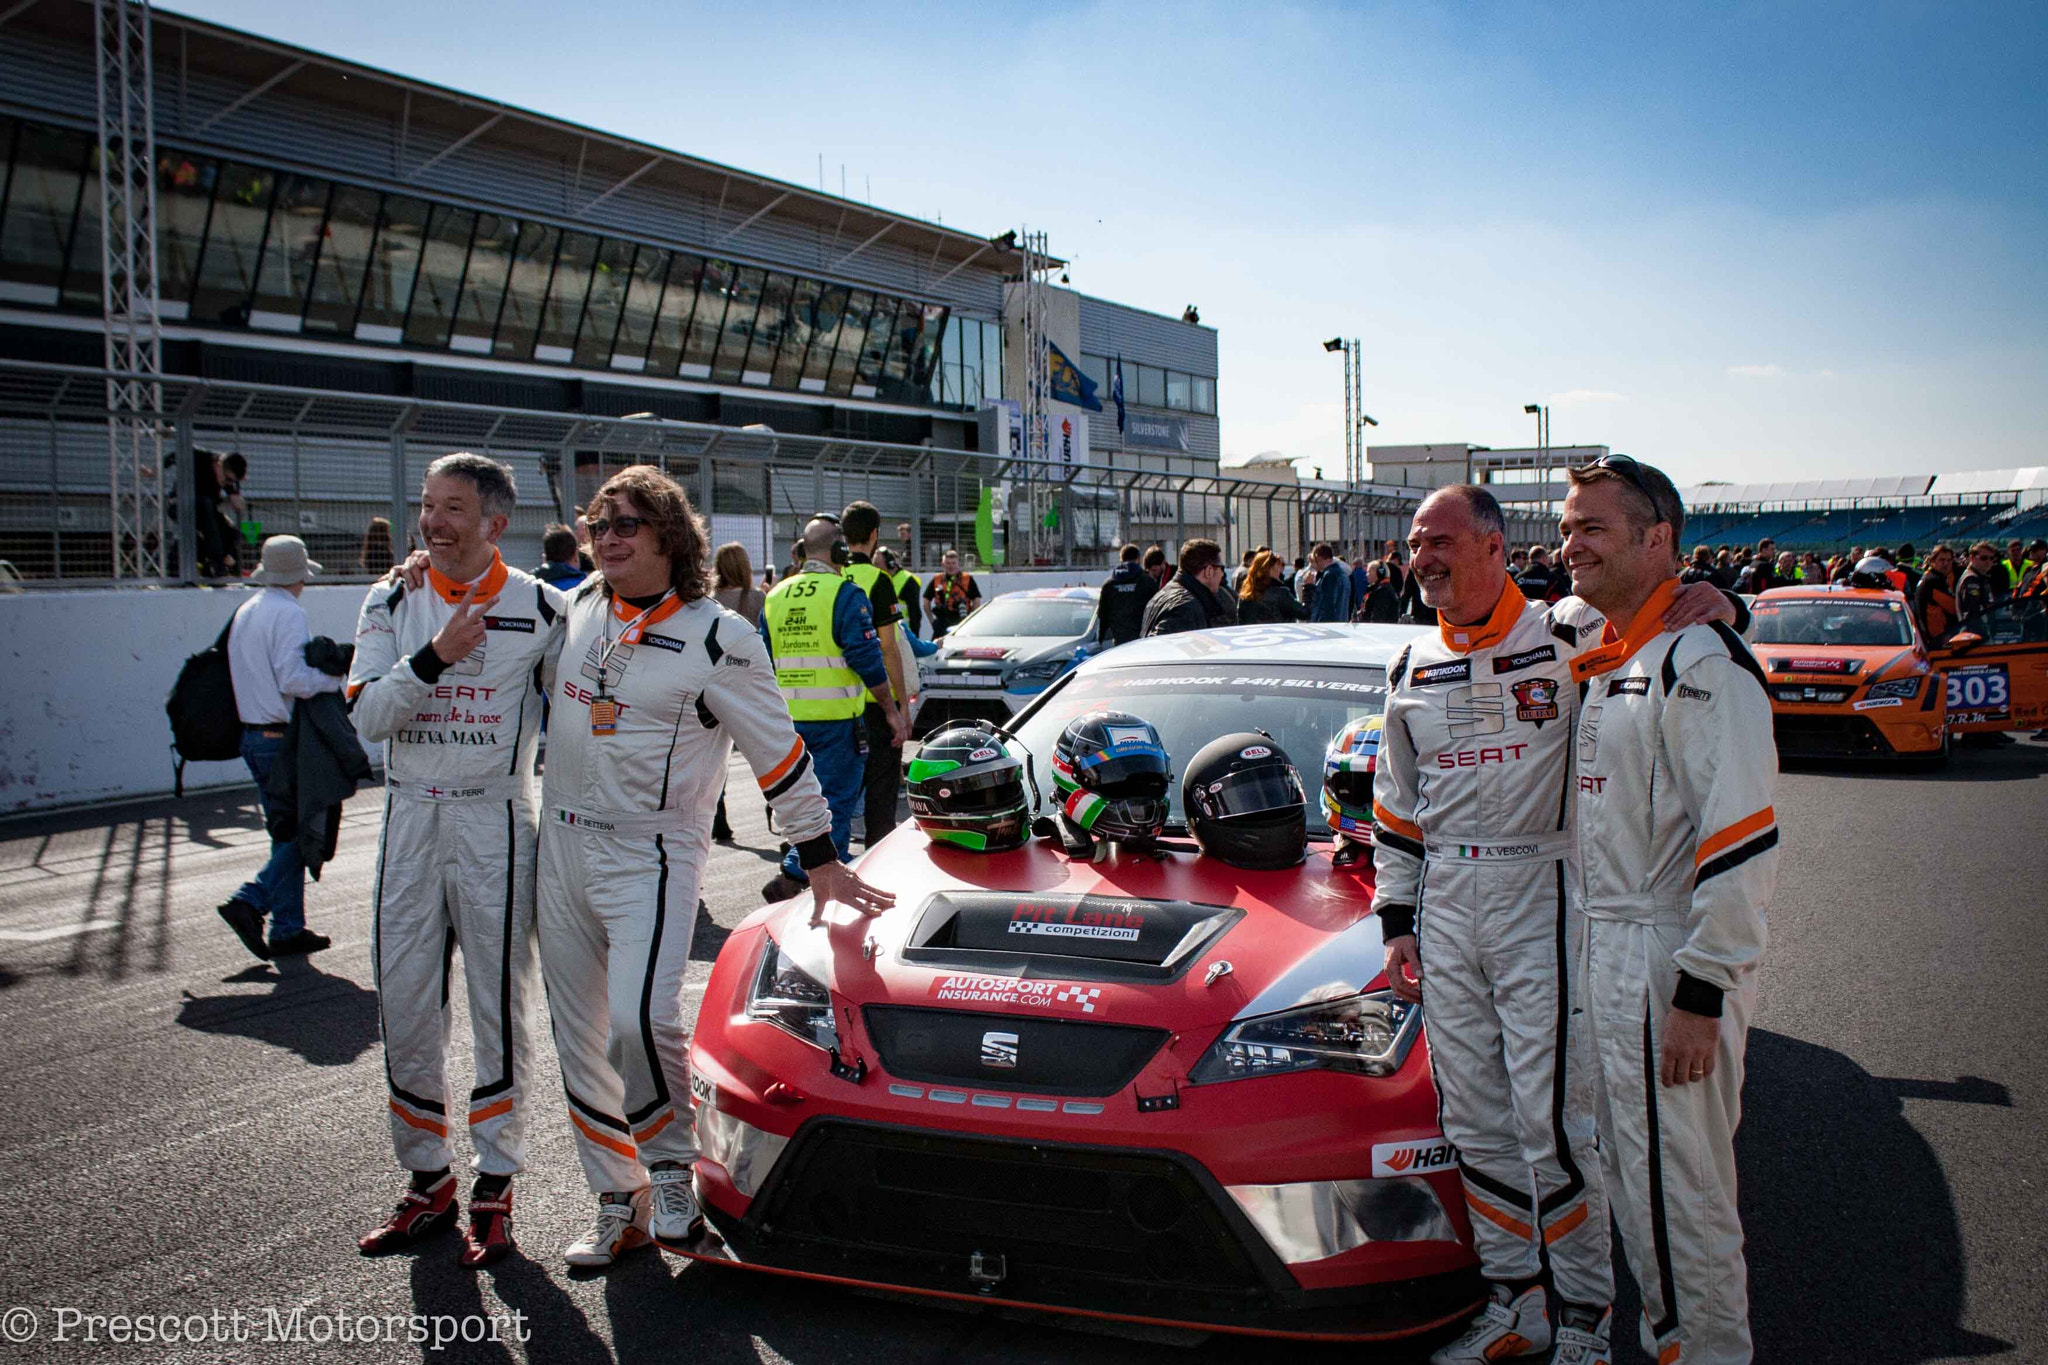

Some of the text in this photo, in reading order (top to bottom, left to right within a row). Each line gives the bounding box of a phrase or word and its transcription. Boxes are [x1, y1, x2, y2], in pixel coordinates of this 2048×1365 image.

[1131, 421, 1170, 438] SILVERSTONE
[784, 581, 820, 599] 155
[498, 621, 533, 630] YOKOHAMA
[1578, 617, 1606, 638] freem
[648, 637, 684, 651] YOKOHAMA
[1510, 649, 1553, 666] YOKOHAMA
[427, 685, 497, 700] EAT
[1230, 676, 1281, 688] 24H
[1282, 679, 1388, 694] SILVERST
[1678, 684, 1711, 701] freem
[1947, 675, 2008, 708] 303
[563, 681, 631, 716] SET
[478, 713, 502, 724] rose
[397, 729, 498, 746] CUEVA MAYA
[972, 748, 995, 758] BELL
[1244, 747, 1267, 757] BELL
[1437, 743, 1529, 770] SEAT
[462, 787, 486, 797] FERRI
[1576, 776, 1607, 794] AT
[583, 817, 615, 832] BETTERA
[1485, 845, 1539, 857] A. VESCOVI
[1012, 903, 1144, 929] Pit Lane
[1045, 923, 1136, 939] competizioni
[942, 976, 1058, 995] AUTOSPORT
[937, 988, 1052, 1006] INSURANCE.COM
